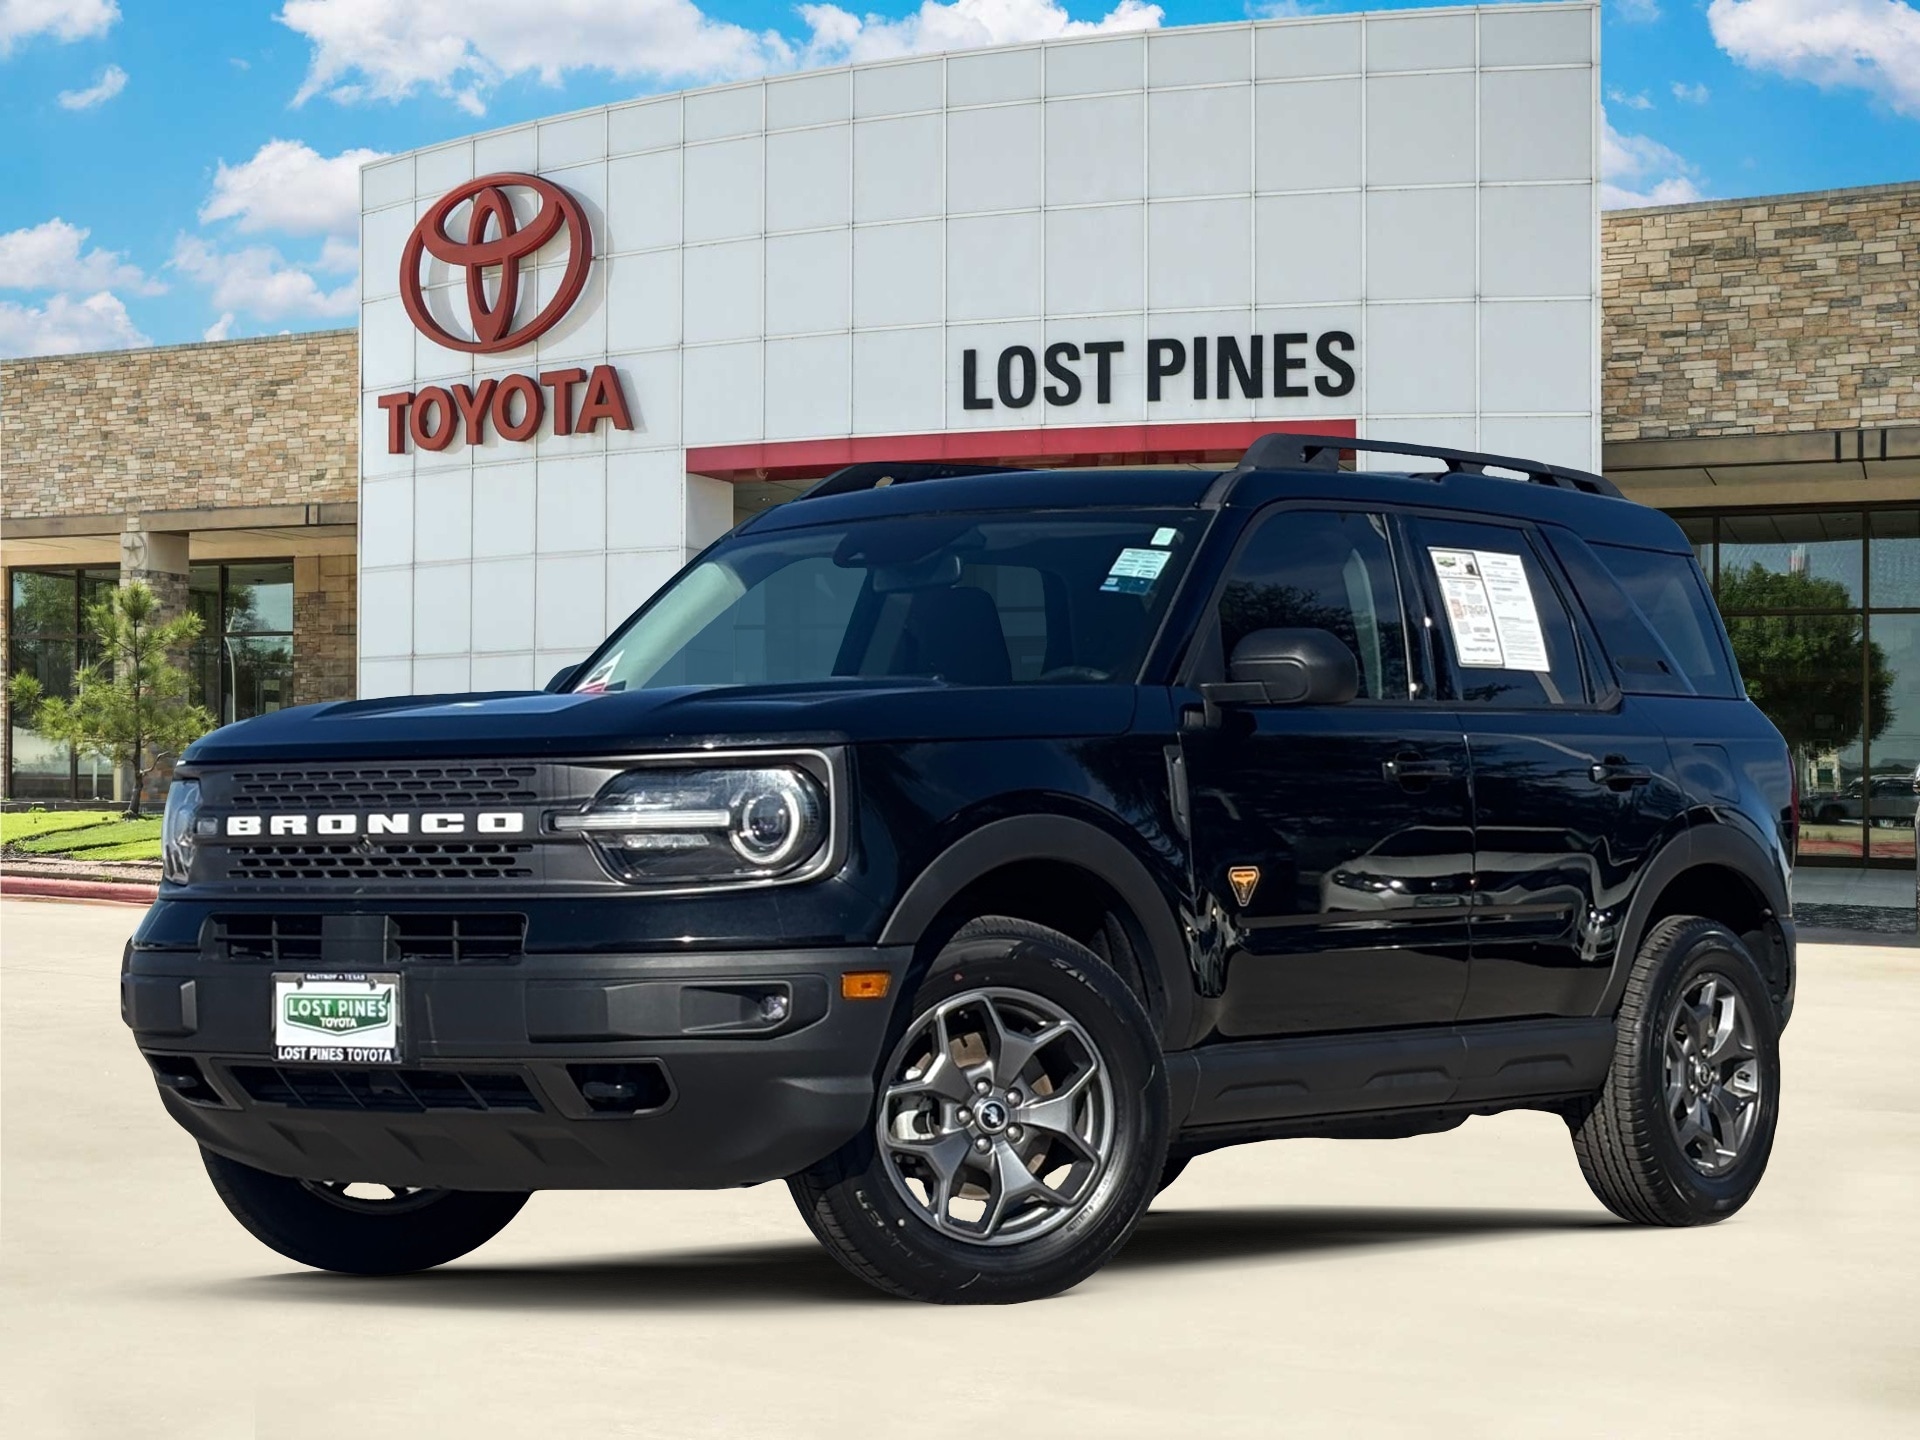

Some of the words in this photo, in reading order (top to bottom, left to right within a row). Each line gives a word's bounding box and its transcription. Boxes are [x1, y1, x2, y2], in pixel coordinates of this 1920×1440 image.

[963, 340, 1125, 410] LOST
[1147, 330, 1356, 403] PINES
[378, 364, 635, 454] TOYOTA
[226, 812, 524, 836] BRONCO
[288, 999, 332, 1016] LOST
[338, 1000, 387, 1017] PINES
[319, 1017, 358, 1028] TOYOTA
[278, 1046, 307, 1060] LOST
[310, 1047, 344, 1061] PINES
[347, 1048, 392, 1062] TOYOTA
